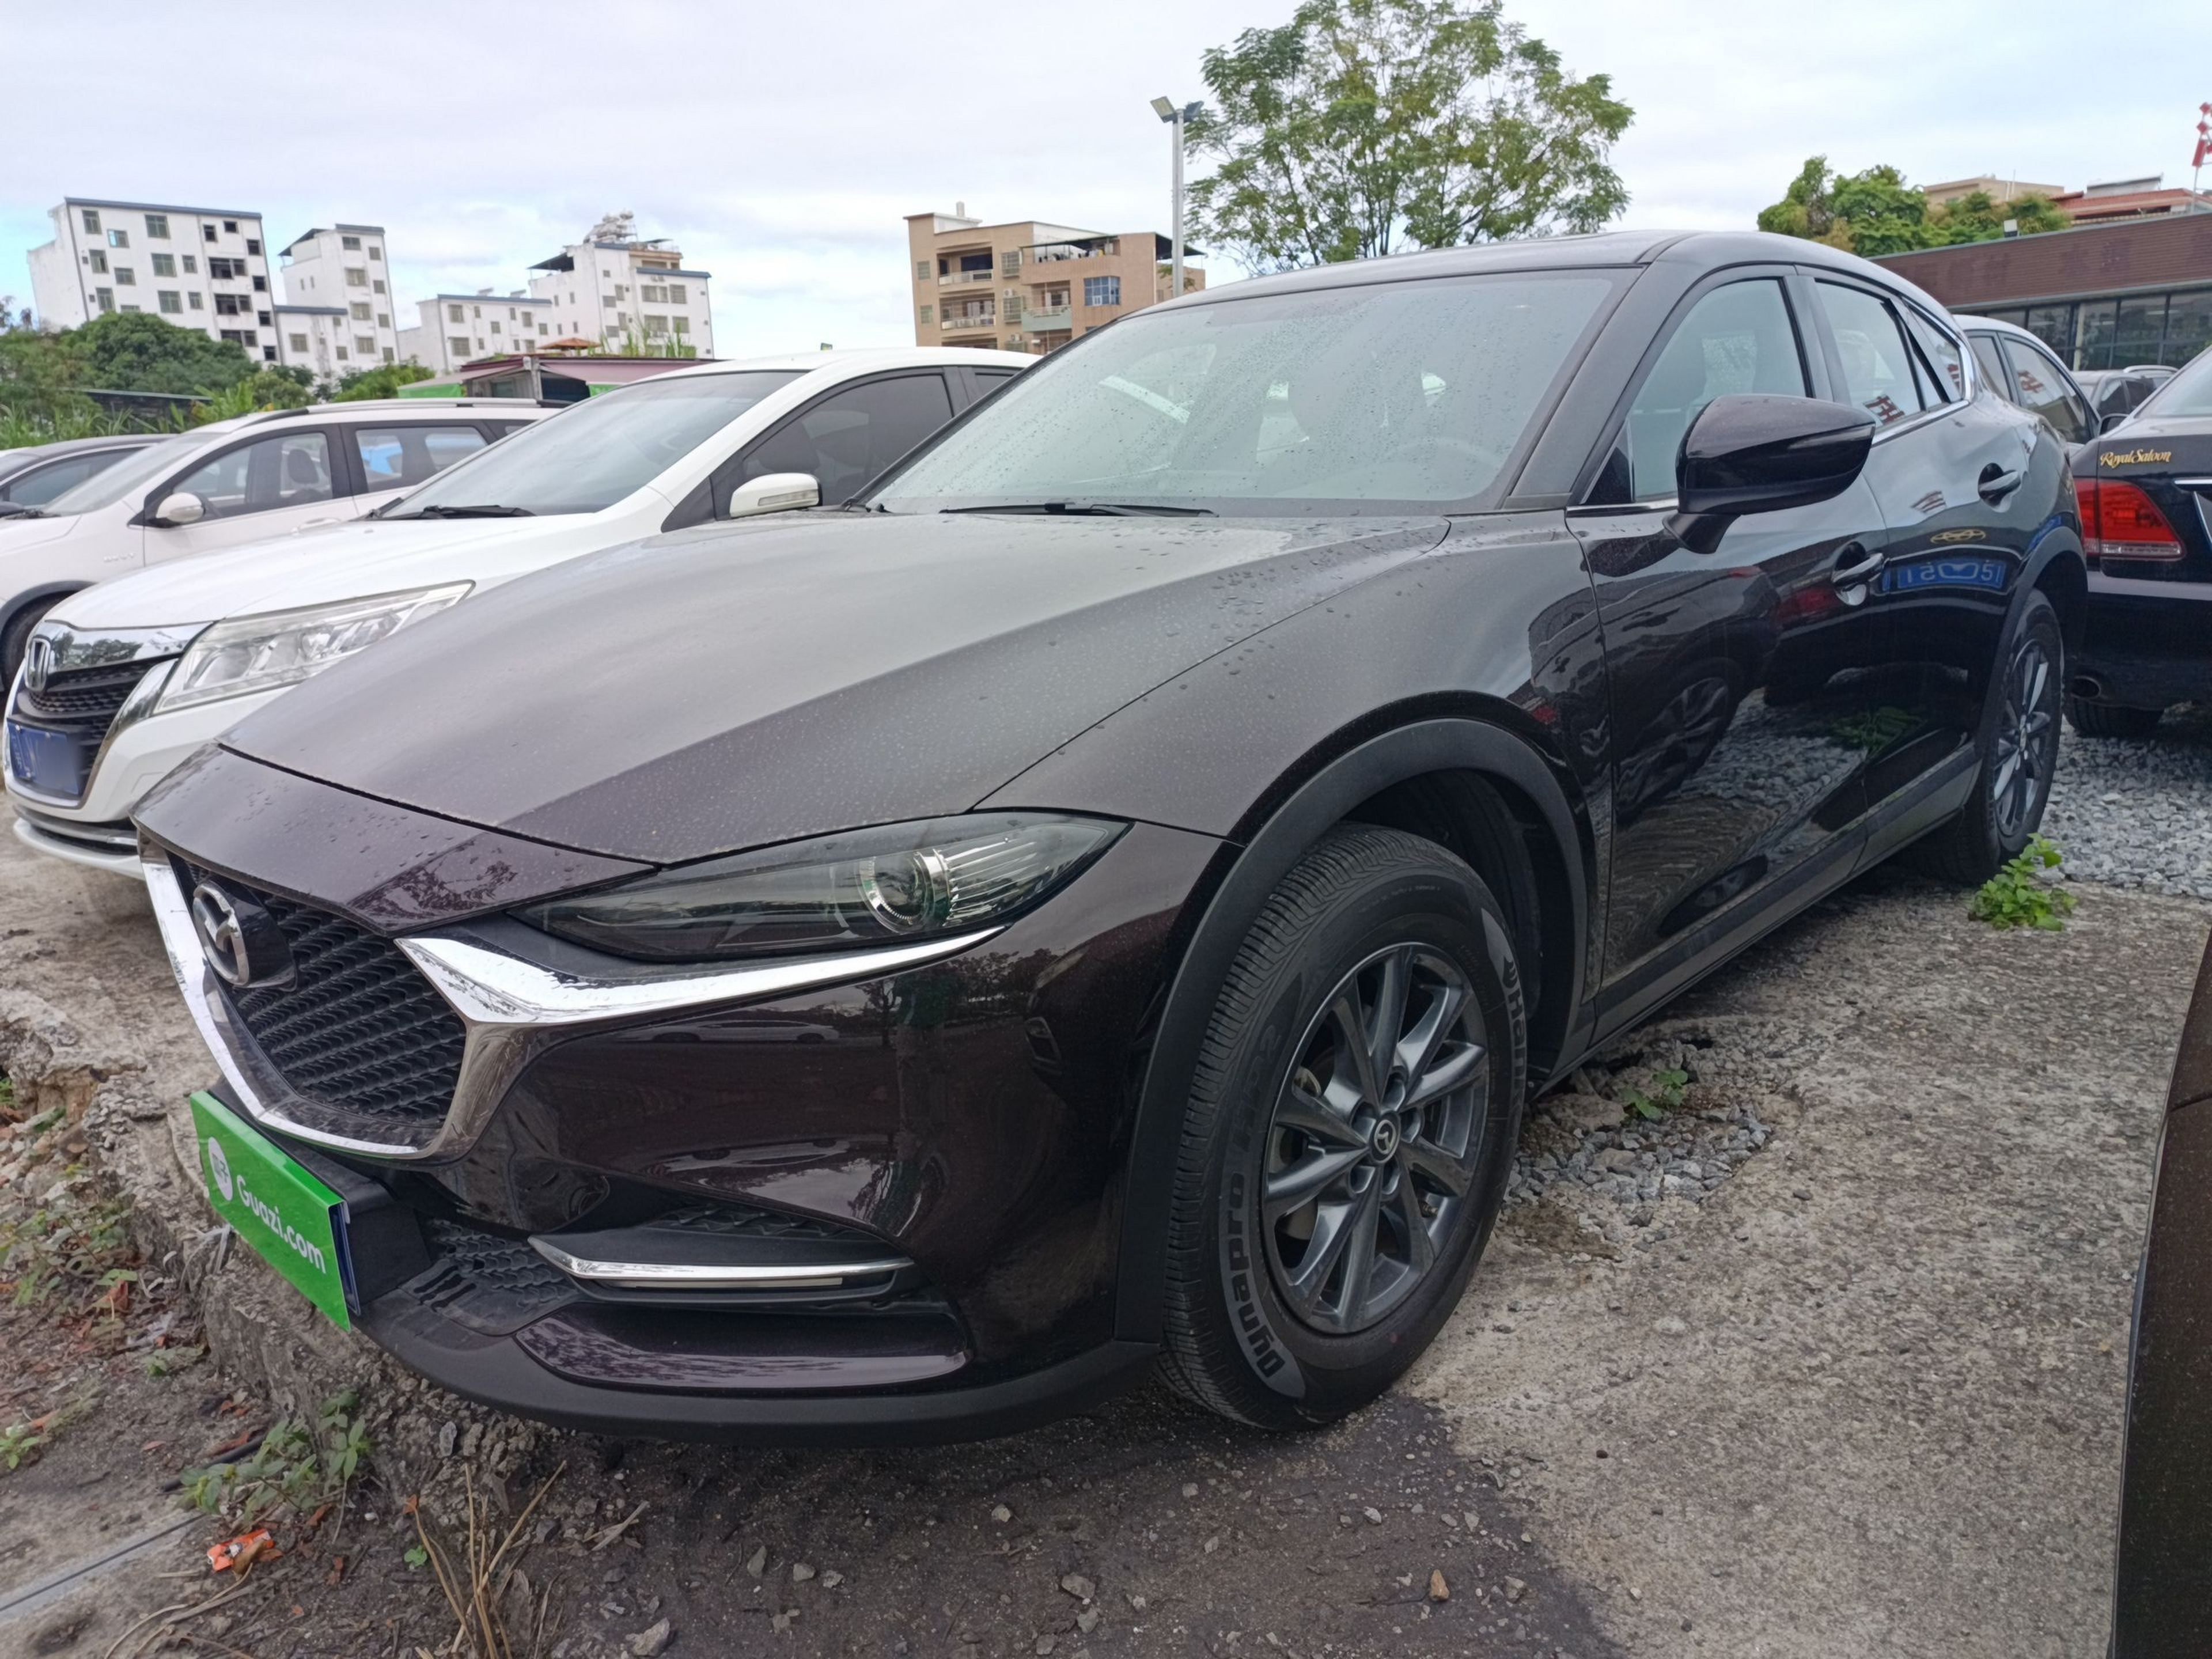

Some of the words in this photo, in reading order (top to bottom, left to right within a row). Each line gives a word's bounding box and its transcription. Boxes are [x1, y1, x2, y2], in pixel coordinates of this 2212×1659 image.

[2100, 450, 2134, 469] Royal
[2132, 449, 2172, 463] Saloon
[237, 1175, 327, 1275] Guazi.com
[1227, 1172, 1286, 1378] Dynapro
